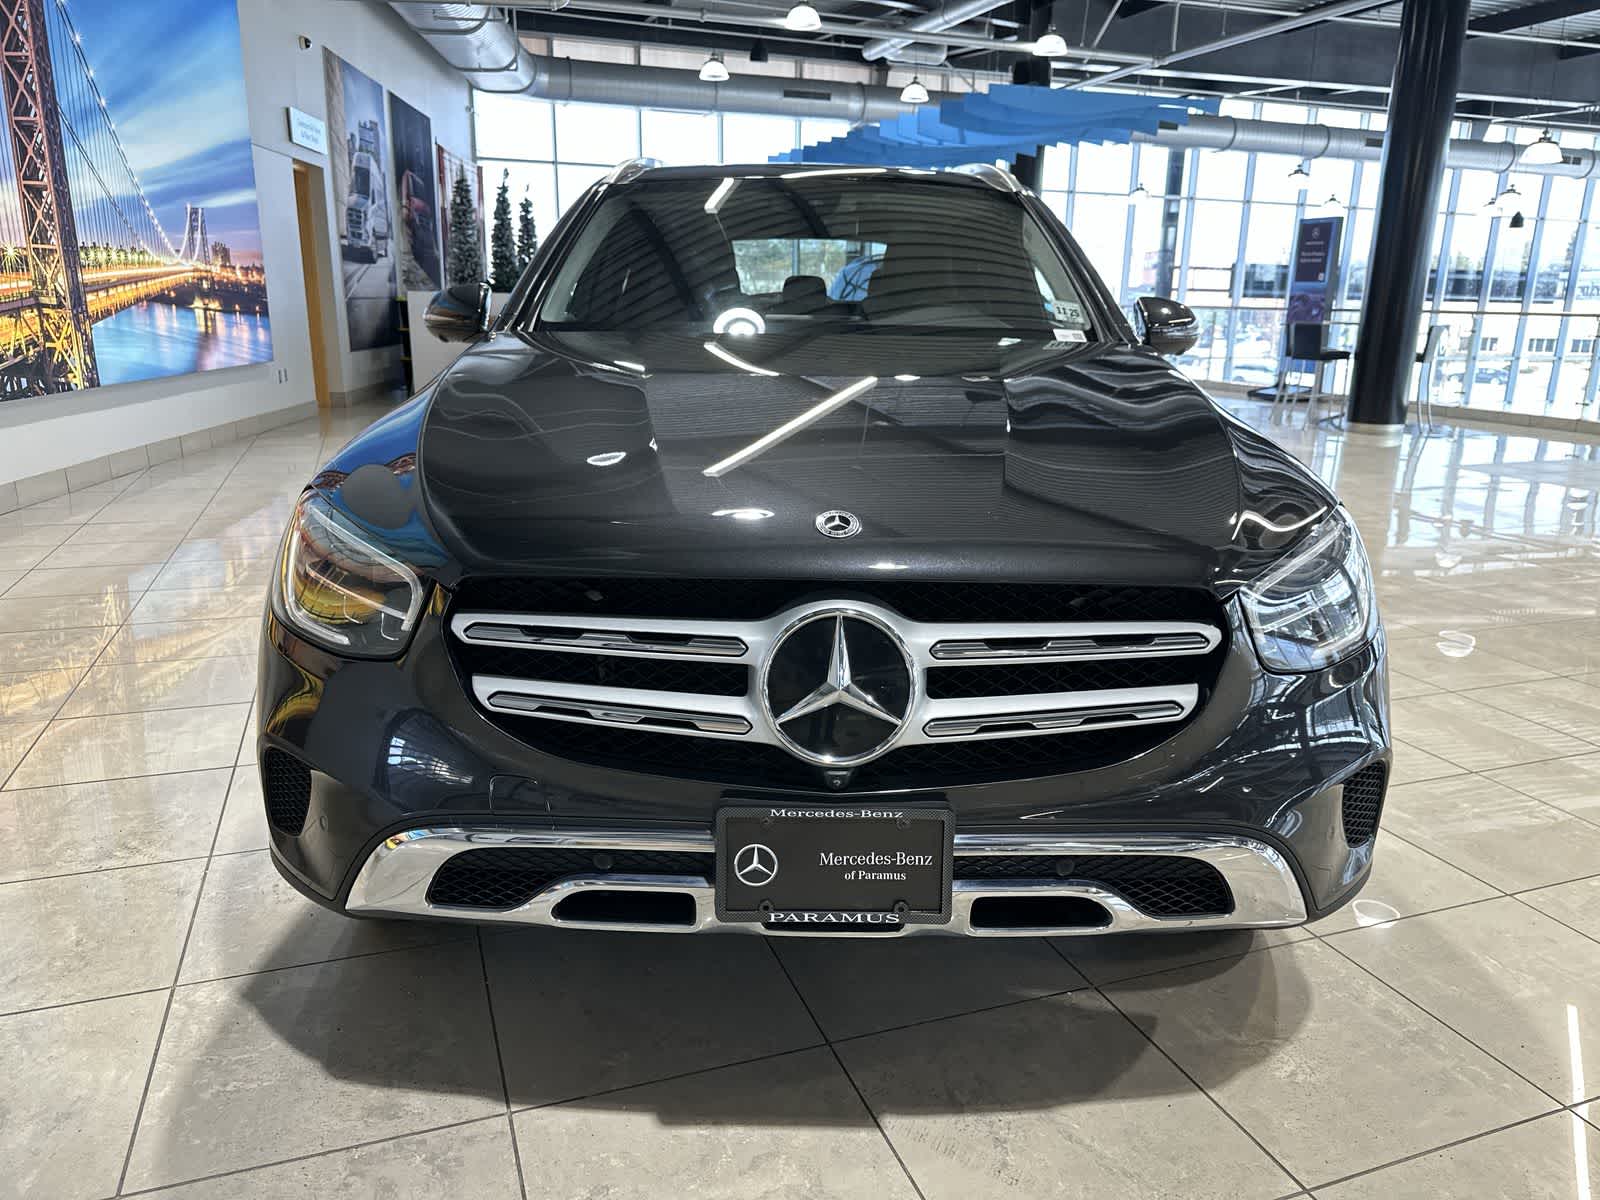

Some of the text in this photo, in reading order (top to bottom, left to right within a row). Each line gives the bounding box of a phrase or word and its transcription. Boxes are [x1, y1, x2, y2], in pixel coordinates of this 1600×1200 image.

[770, 808, 904, 819] Mercedes-Benz
[819, 851, 933, 867] Mercedes-Benz
[844, 870, 907, 881] of Paramus
[769, 912, 900, 924] PARAMUS
